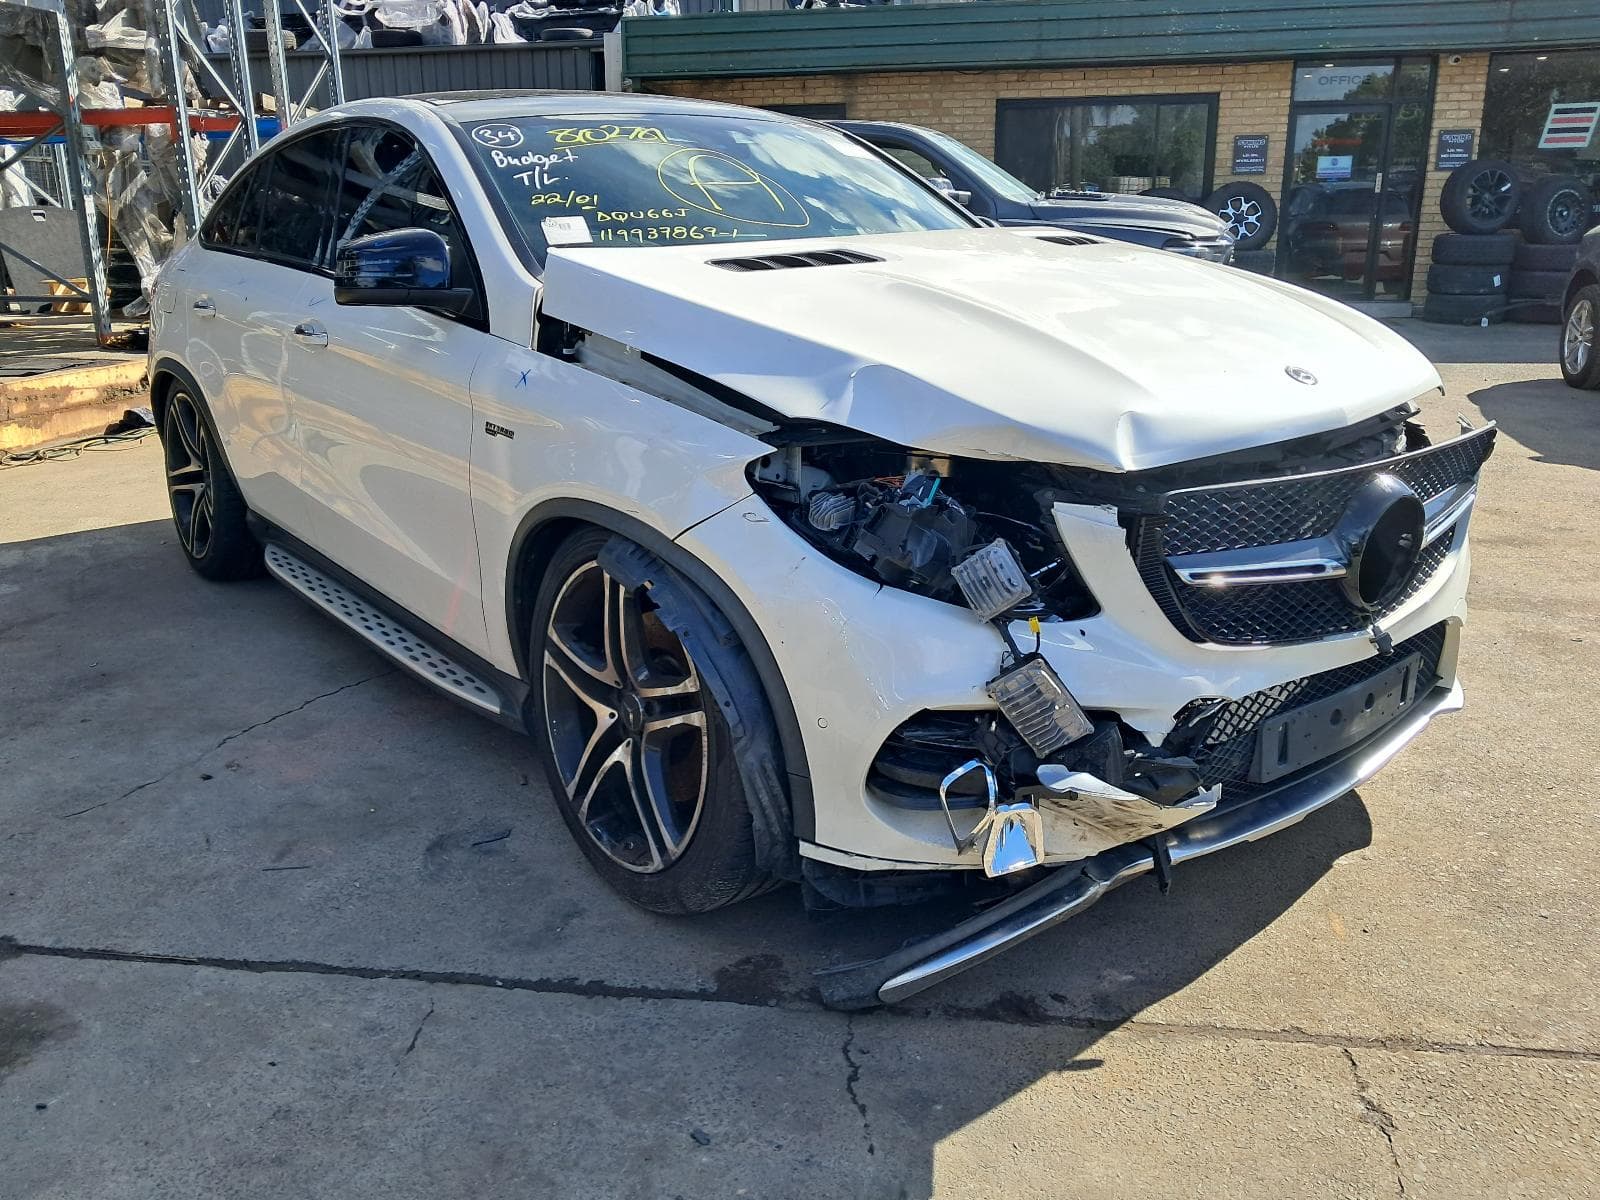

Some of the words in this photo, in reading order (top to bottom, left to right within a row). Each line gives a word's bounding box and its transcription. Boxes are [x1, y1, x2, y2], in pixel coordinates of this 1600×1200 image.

[1318, 75, 1371, 86] OFFICE
[478, 128, 518, 144] 34
[491, 149, 579, 170] Budget
